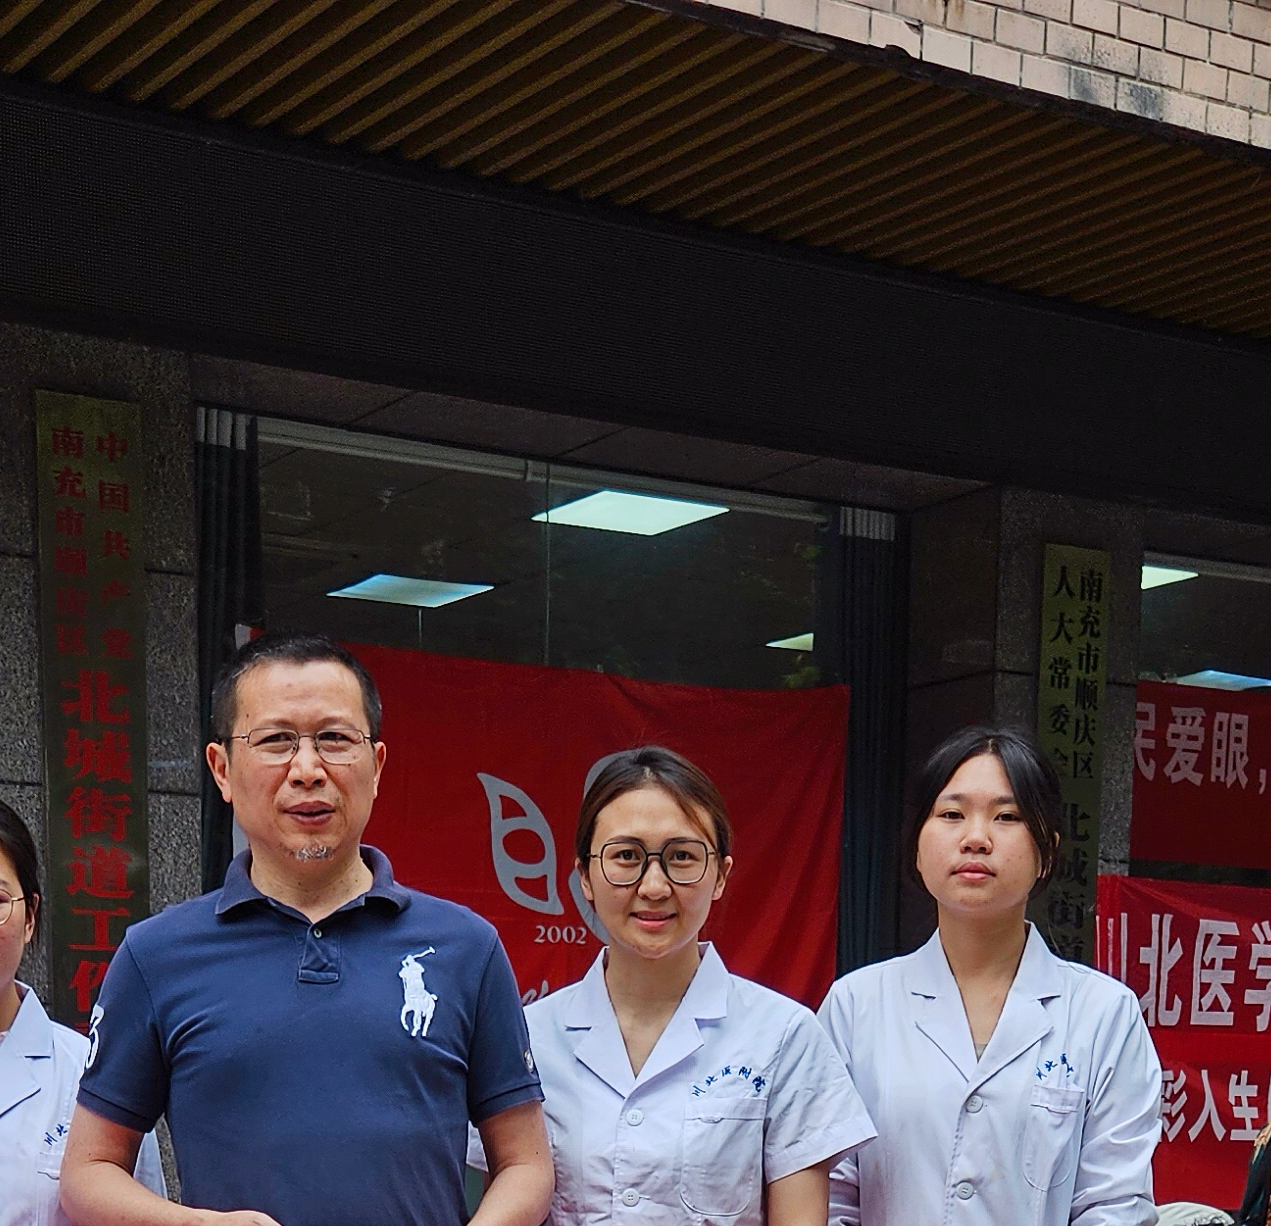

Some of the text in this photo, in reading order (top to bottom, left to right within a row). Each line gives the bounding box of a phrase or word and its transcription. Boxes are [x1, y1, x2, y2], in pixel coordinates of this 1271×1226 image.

[50, 424, 90, 658] 南充市顺庆区
[96, 431, 133, 661] 中国共产党
[1072, 568, 1103, 779] 南充市顺庆区
[60, 669, 135, 1037] 北城街道工作
[534, 924, 587, 945] 2002
